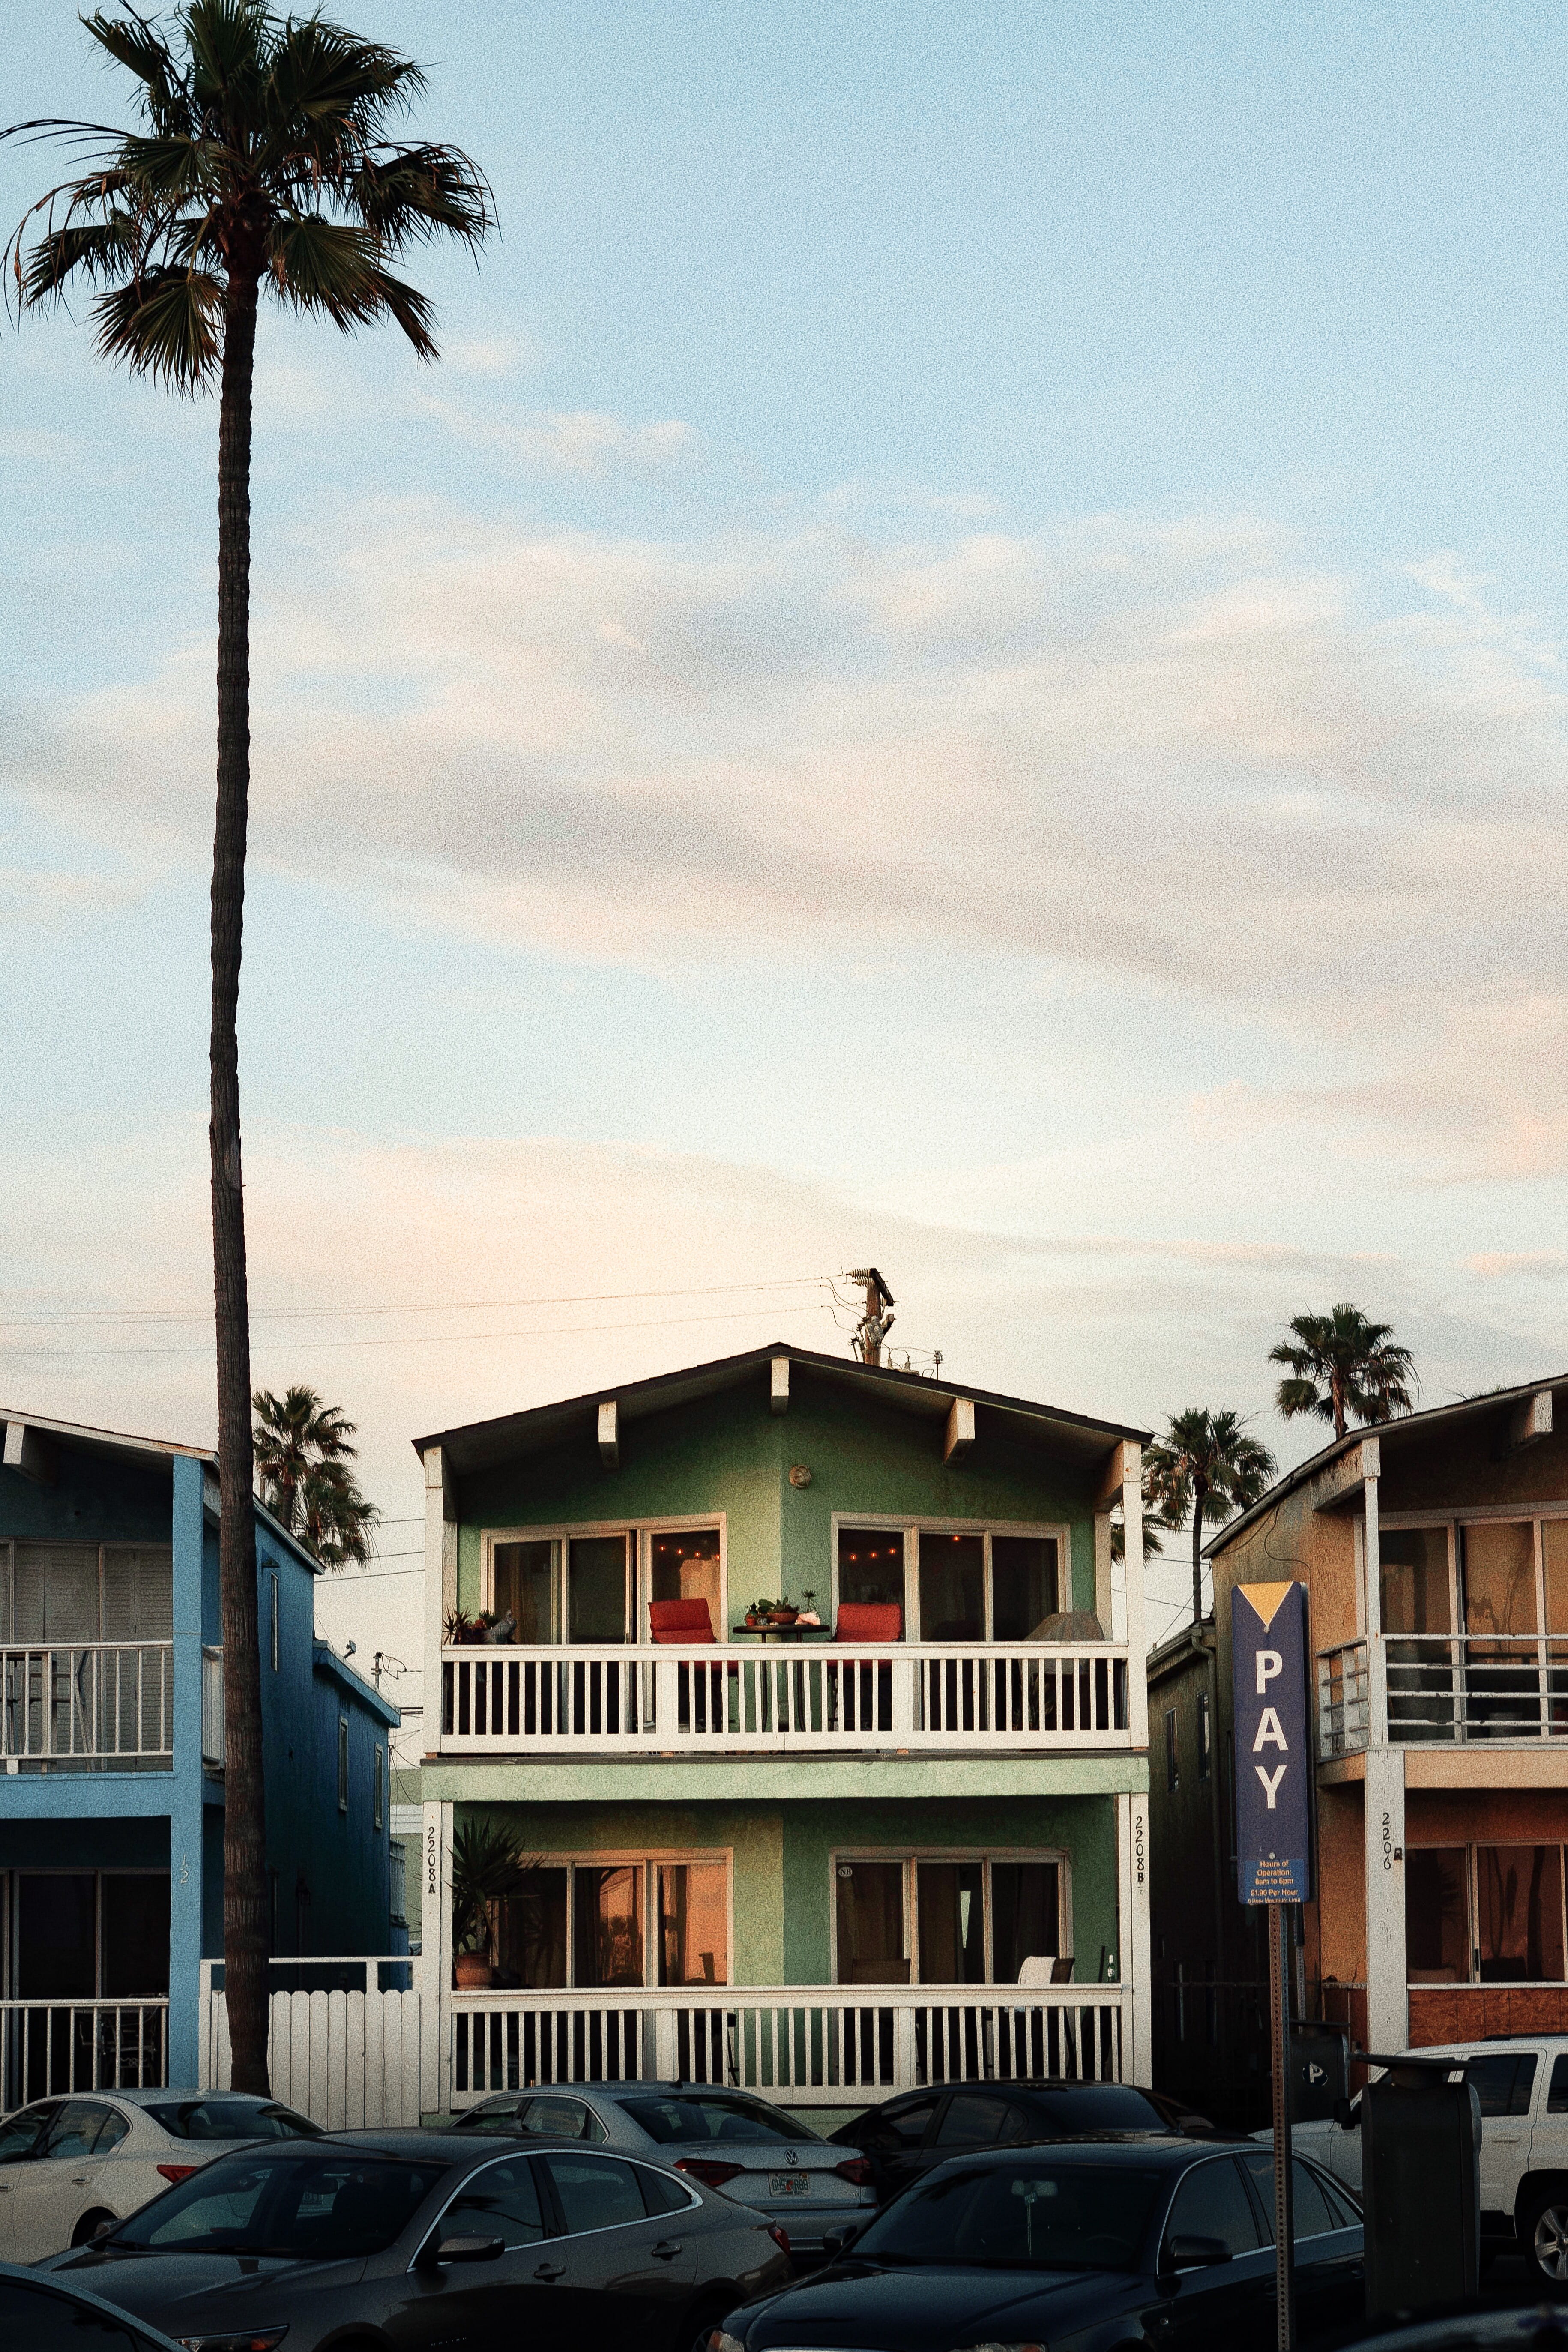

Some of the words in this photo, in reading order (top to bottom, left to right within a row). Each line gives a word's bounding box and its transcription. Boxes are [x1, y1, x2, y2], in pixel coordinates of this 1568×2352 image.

[1252, 1649, 1289, 1809] PAY
[1382, 1812, 1392, 1870] 2206
[1279, 1877, 1293, 1886] 6pm
